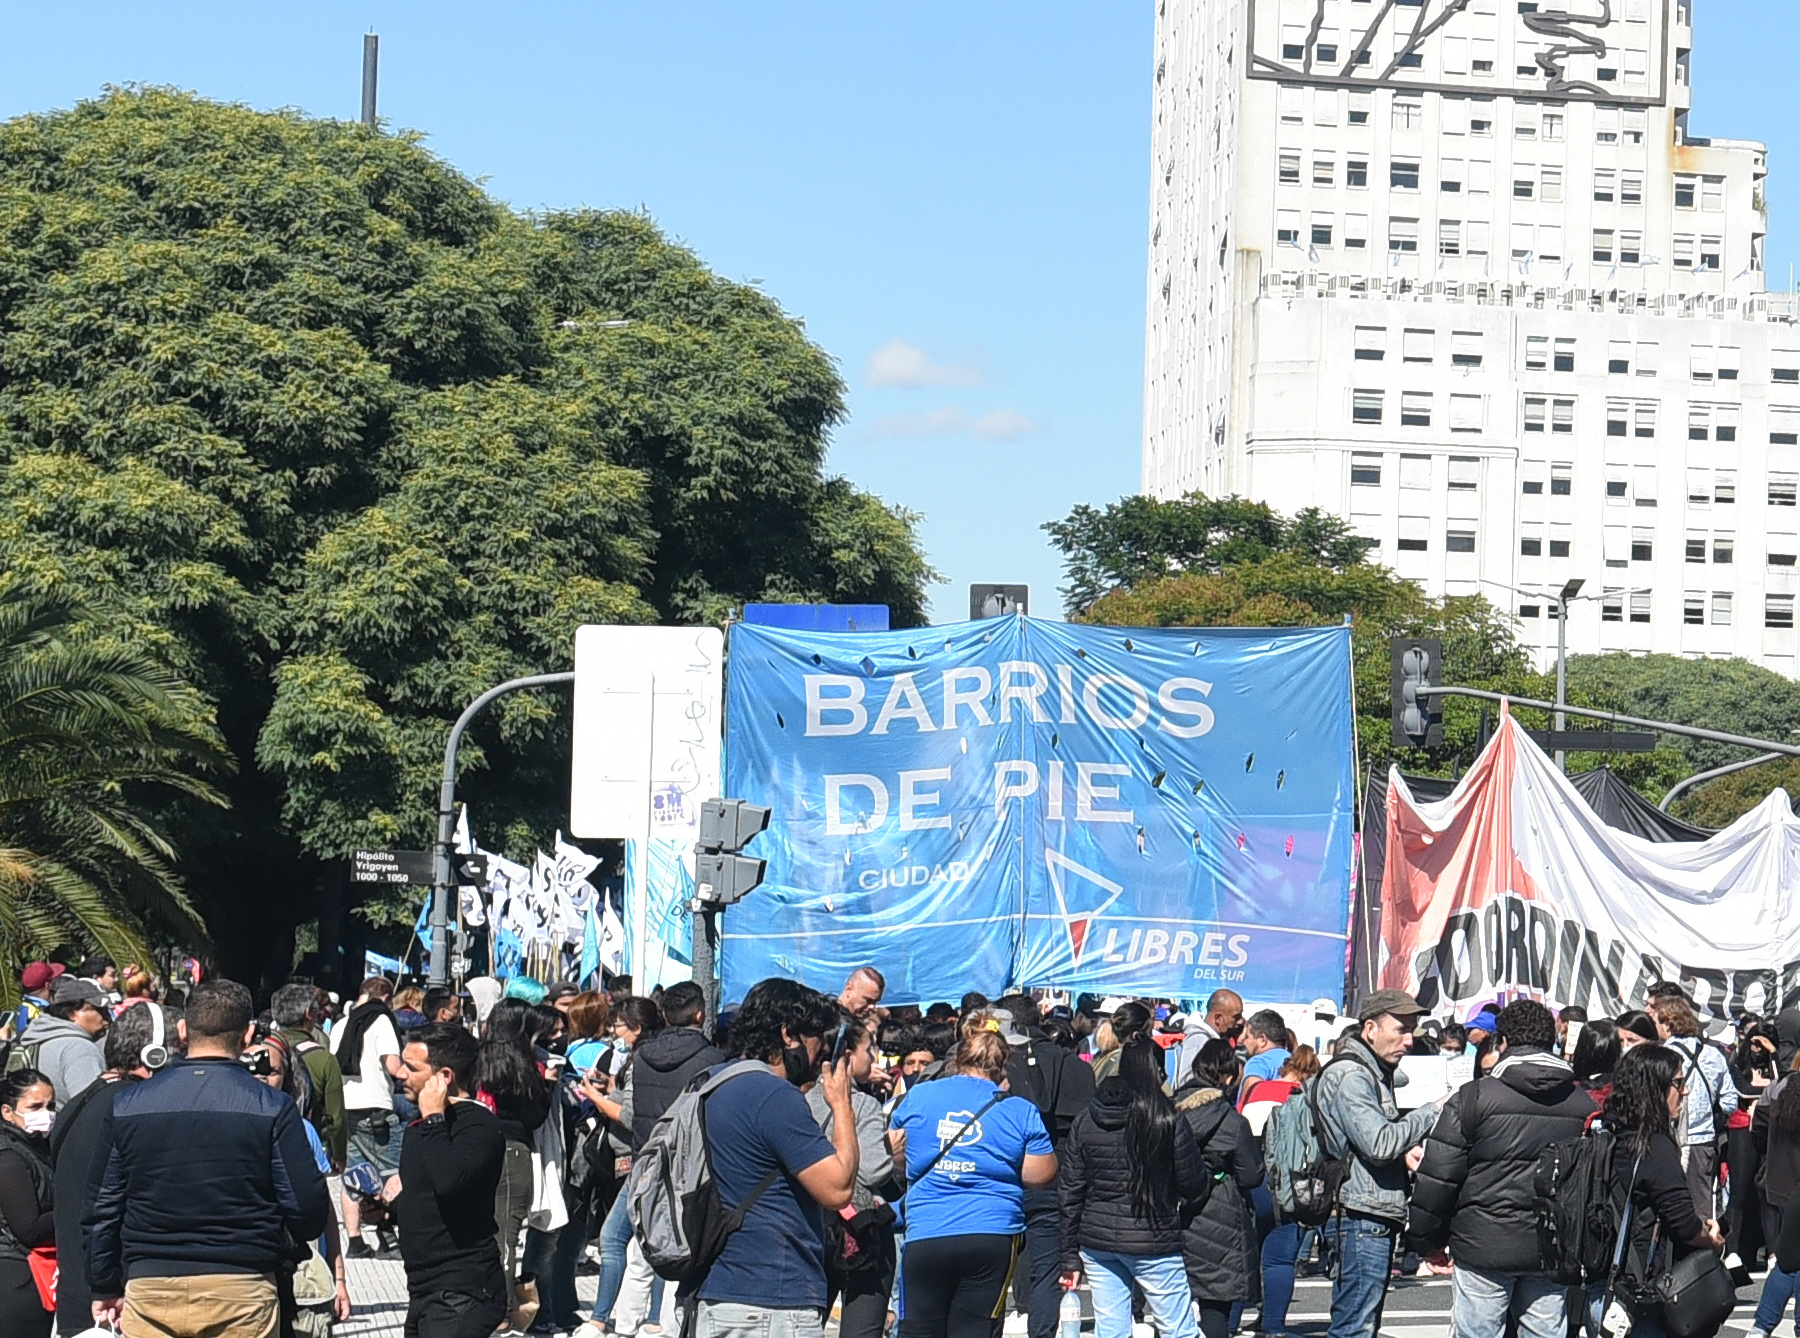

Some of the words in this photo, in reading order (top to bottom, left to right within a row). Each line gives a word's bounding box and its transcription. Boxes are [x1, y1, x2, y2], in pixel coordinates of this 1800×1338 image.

[803, 661, 1215, 738] BARRIOS
[824, 765, 952, 835] DE
[994, 760, 1133, 824] PIE
[356, 850, 394, 862] Hipólito
[355, 873, 375, 882] 1000
[356, 862, 399, 873] Yrigoyen
[858, 861, 971, 891] CIUDAD
[1102, 927, 1252, 967] LIBRES
[1193, 967, 1217, 980] DEL
[1219, 969, 1245, 982] SUR
